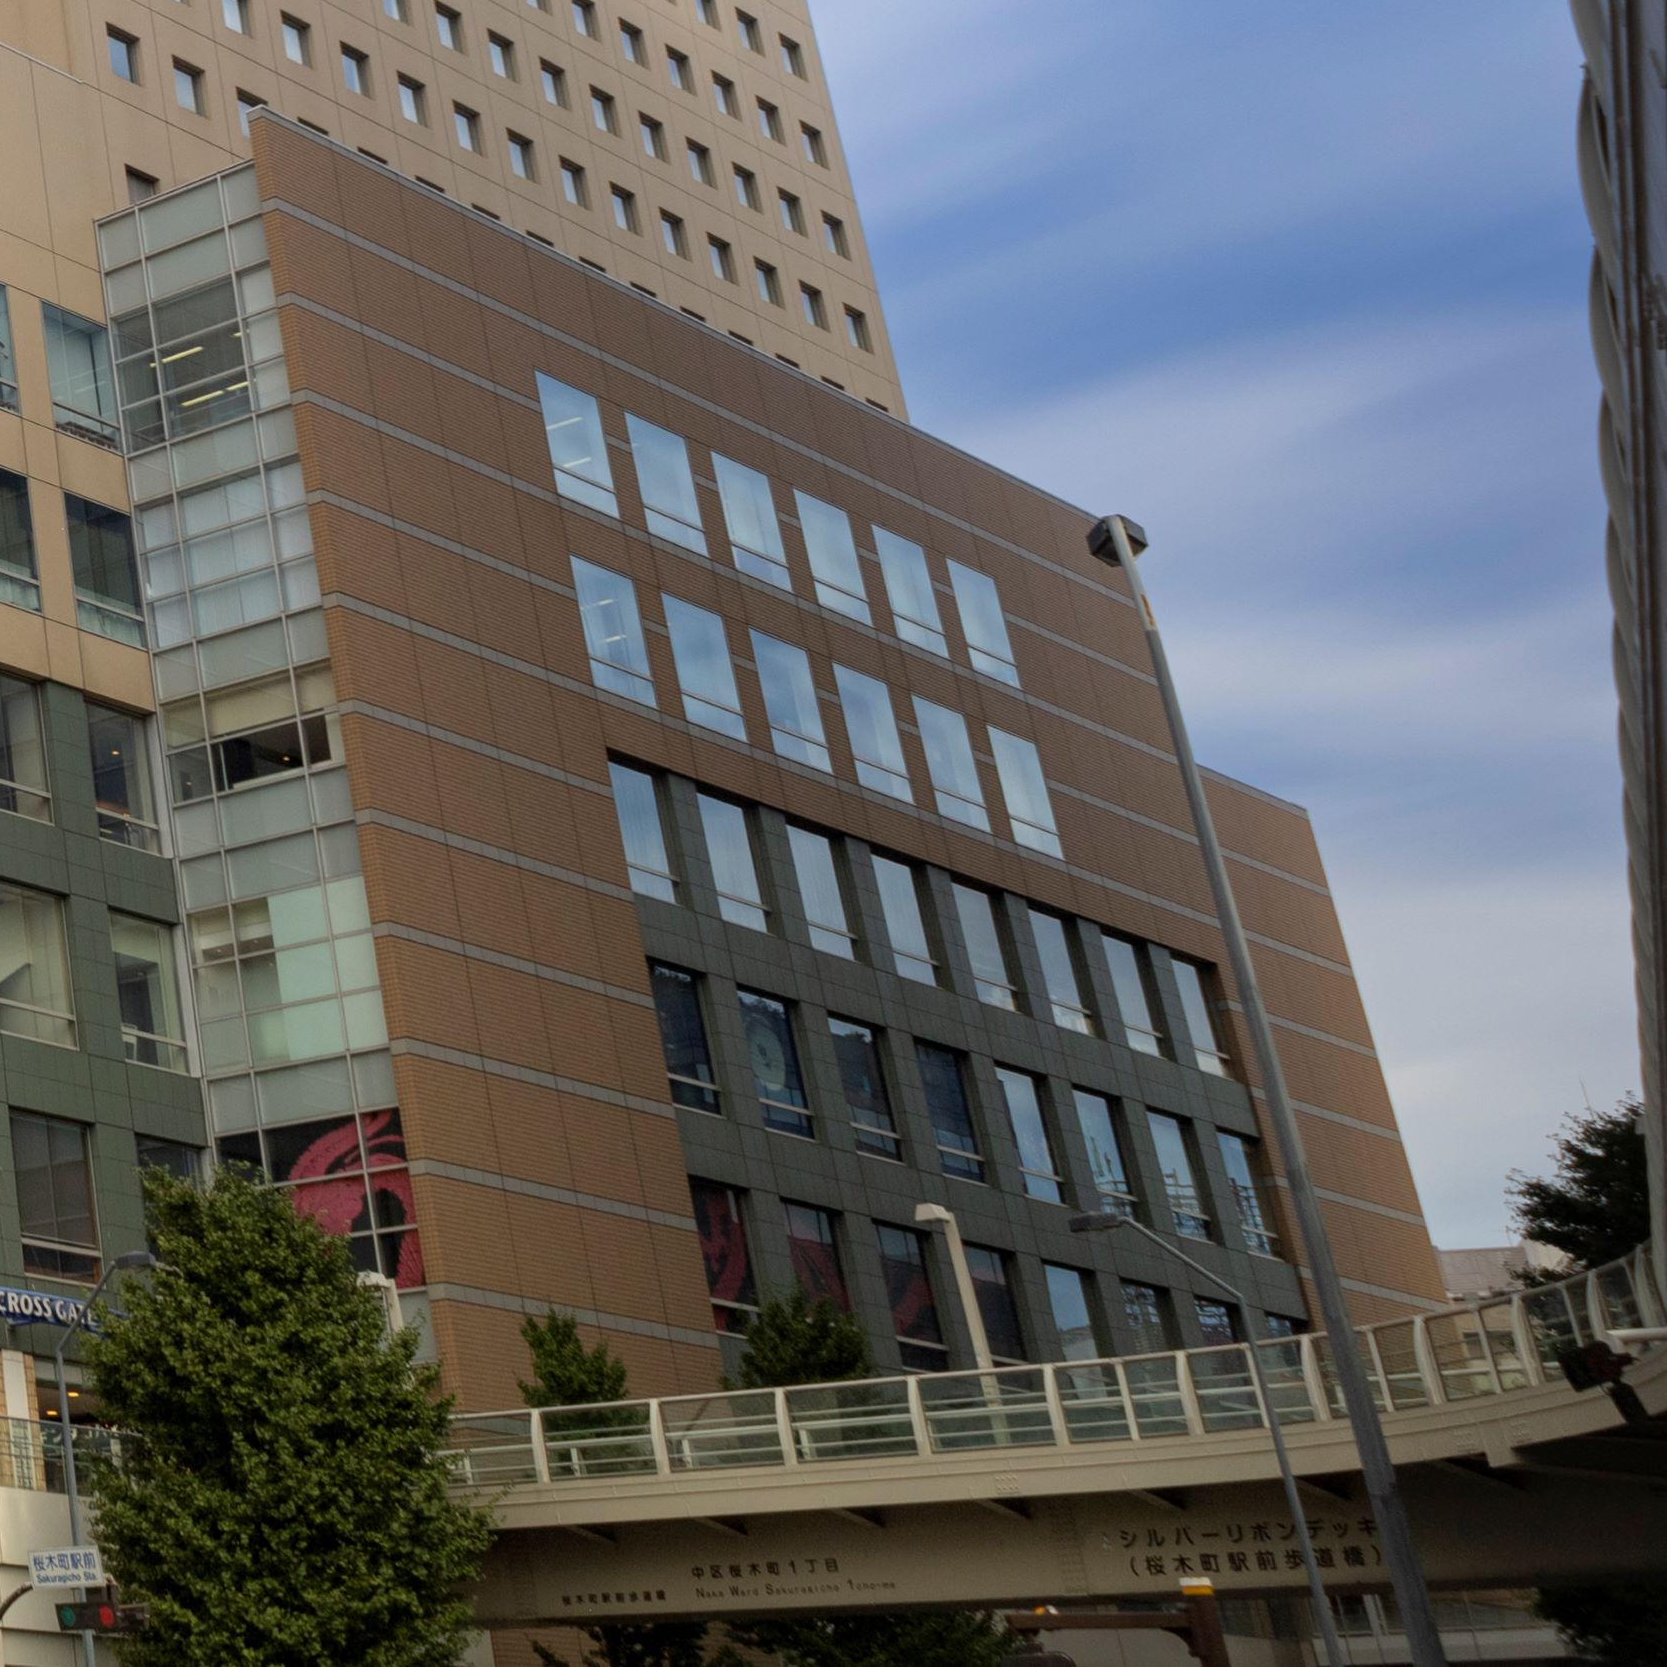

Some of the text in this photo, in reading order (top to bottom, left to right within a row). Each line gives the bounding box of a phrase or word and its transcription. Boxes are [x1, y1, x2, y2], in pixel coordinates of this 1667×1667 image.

[1119, 1517, 1378, 1549] シルバーリボンデッキ
[33, 1551, 96, 1572] 桜木町駅前
[691, 1558, 840, 1580] 中区桜木町1丁目
[696, 1587, 725, 1599] Naka
